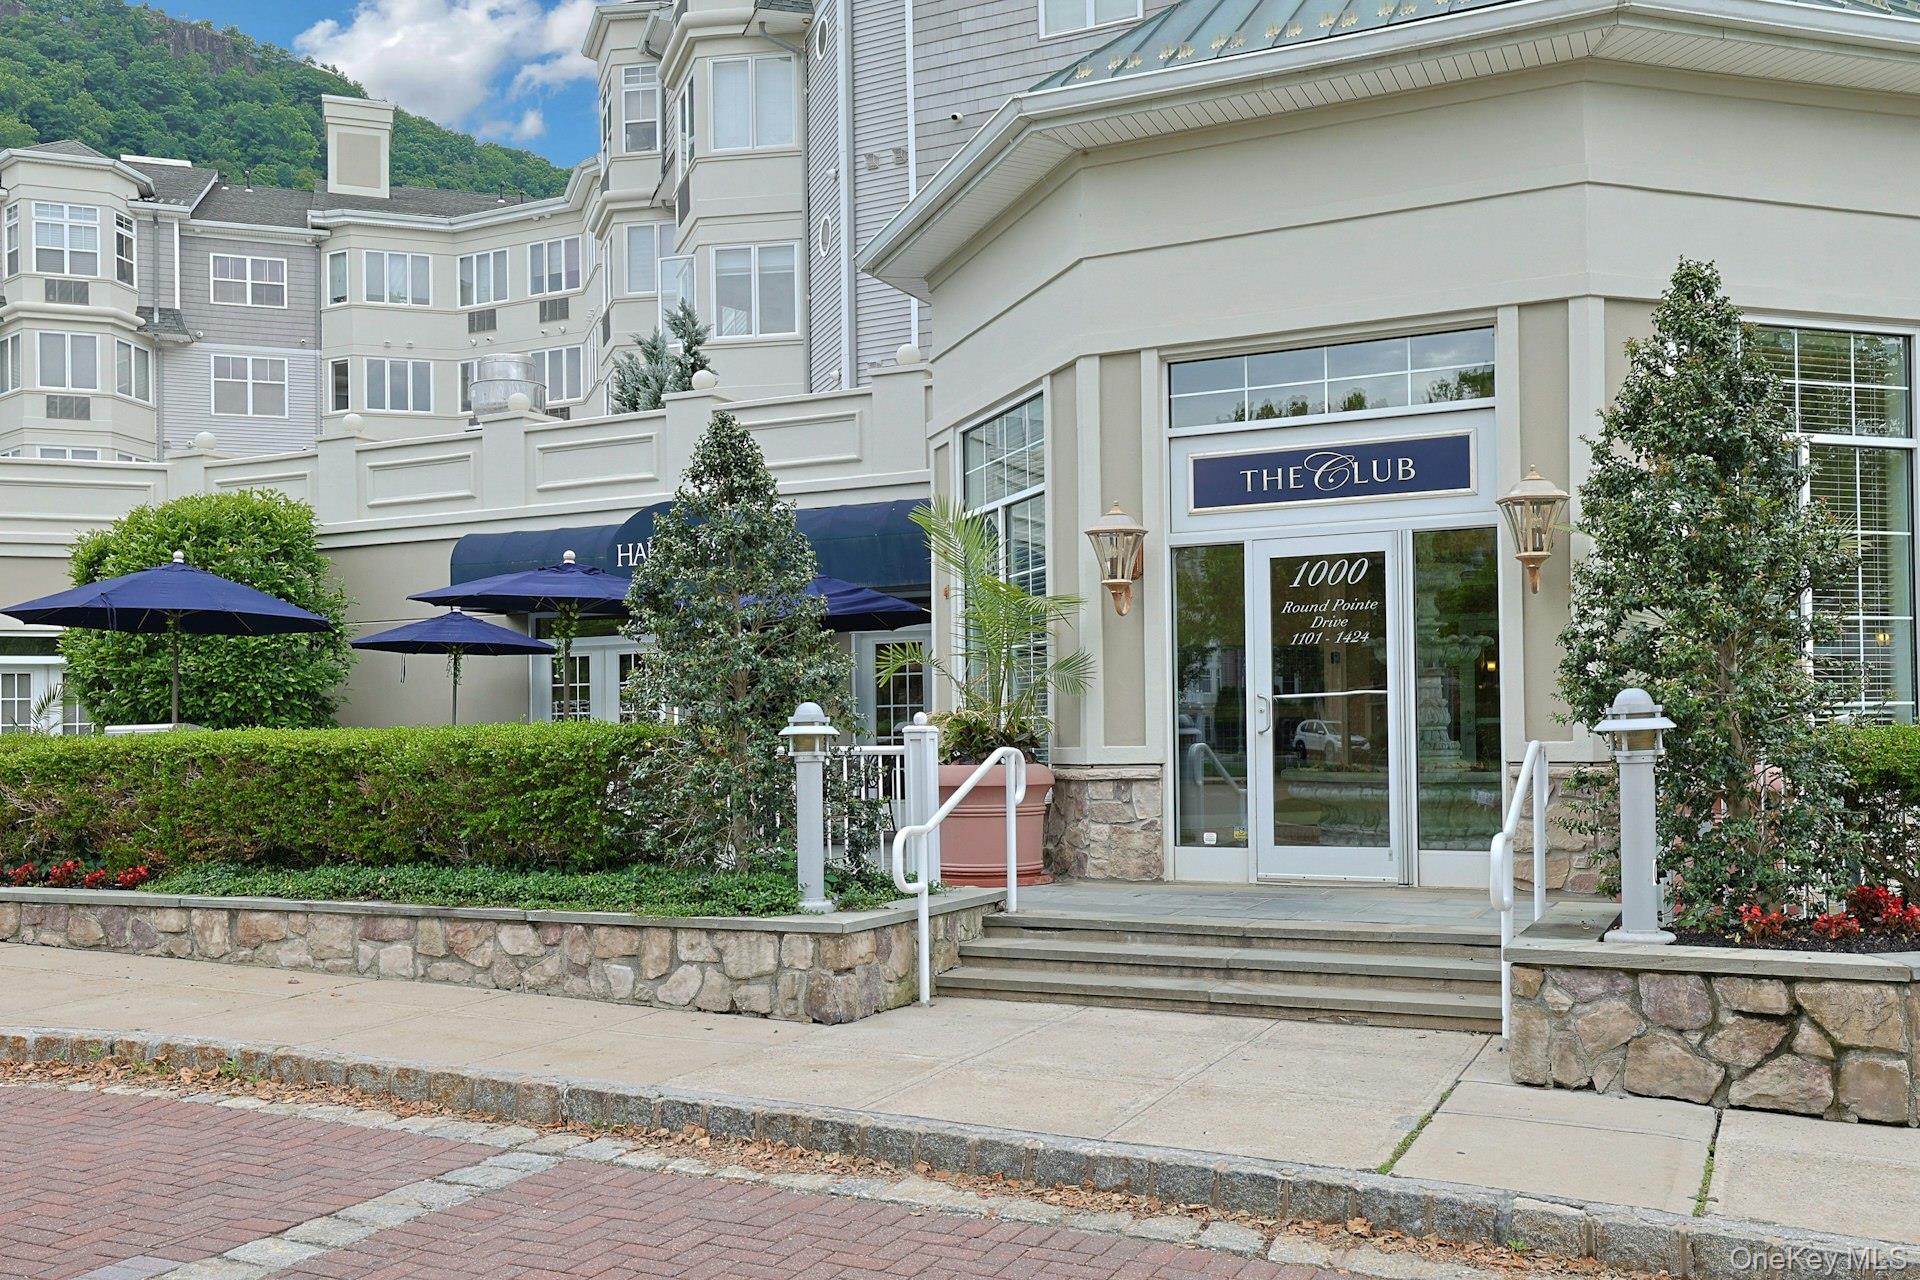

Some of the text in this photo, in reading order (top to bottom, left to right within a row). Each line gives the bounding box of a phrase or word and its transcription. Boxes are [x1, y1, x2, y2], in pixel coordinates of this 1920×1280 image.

[1240, 452, 1416, 492] THE CLUB
[616, 541, 652, 567] HA
[1289, 557, 1368, 588] 1000
[1281, 597, 1379, 614] Round Pointe
[1310, 615, 1349, 629] Drive
[1290, 631, 1323, 645] 1101
[1334, 630, 1370, 644] 1424
